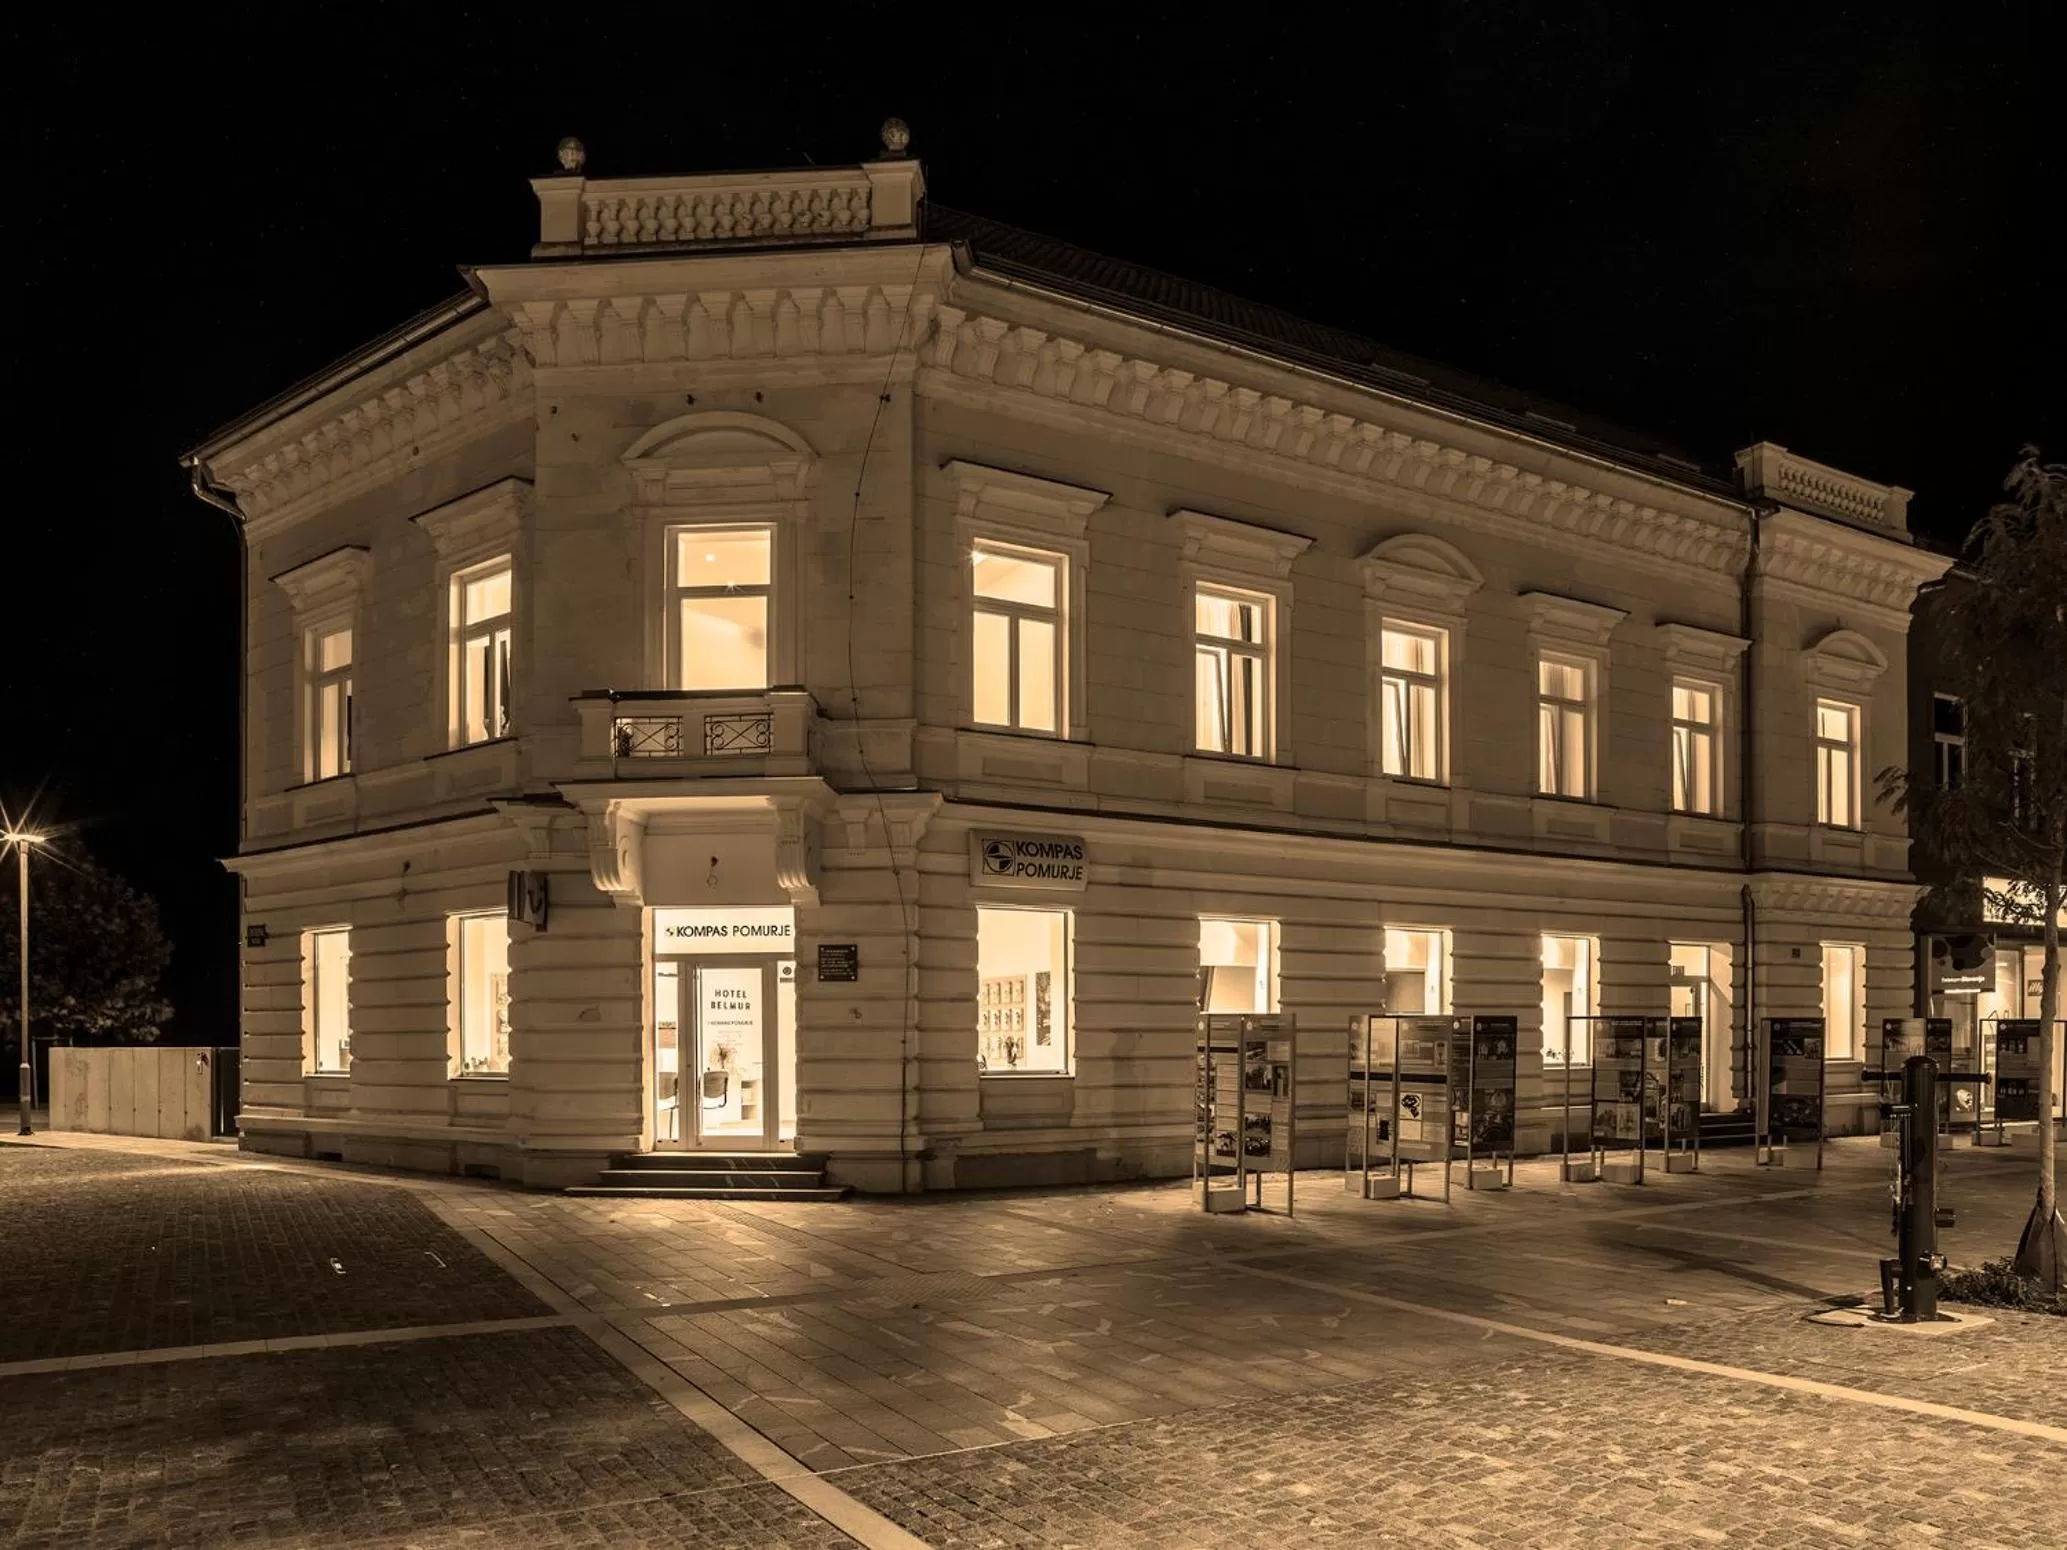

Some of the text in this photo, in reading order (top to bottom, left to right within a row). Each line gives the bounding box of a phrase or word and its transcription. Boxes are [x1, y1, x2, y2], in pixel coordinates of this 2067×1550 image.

[1015, 841, 1083, 860] KOMPAS
[1016, 862, 1084, 880] POMURJE
[676, 925, 791, 937] KOMPAS POMURJE
[714, 989, 747, 999] HOTEL
